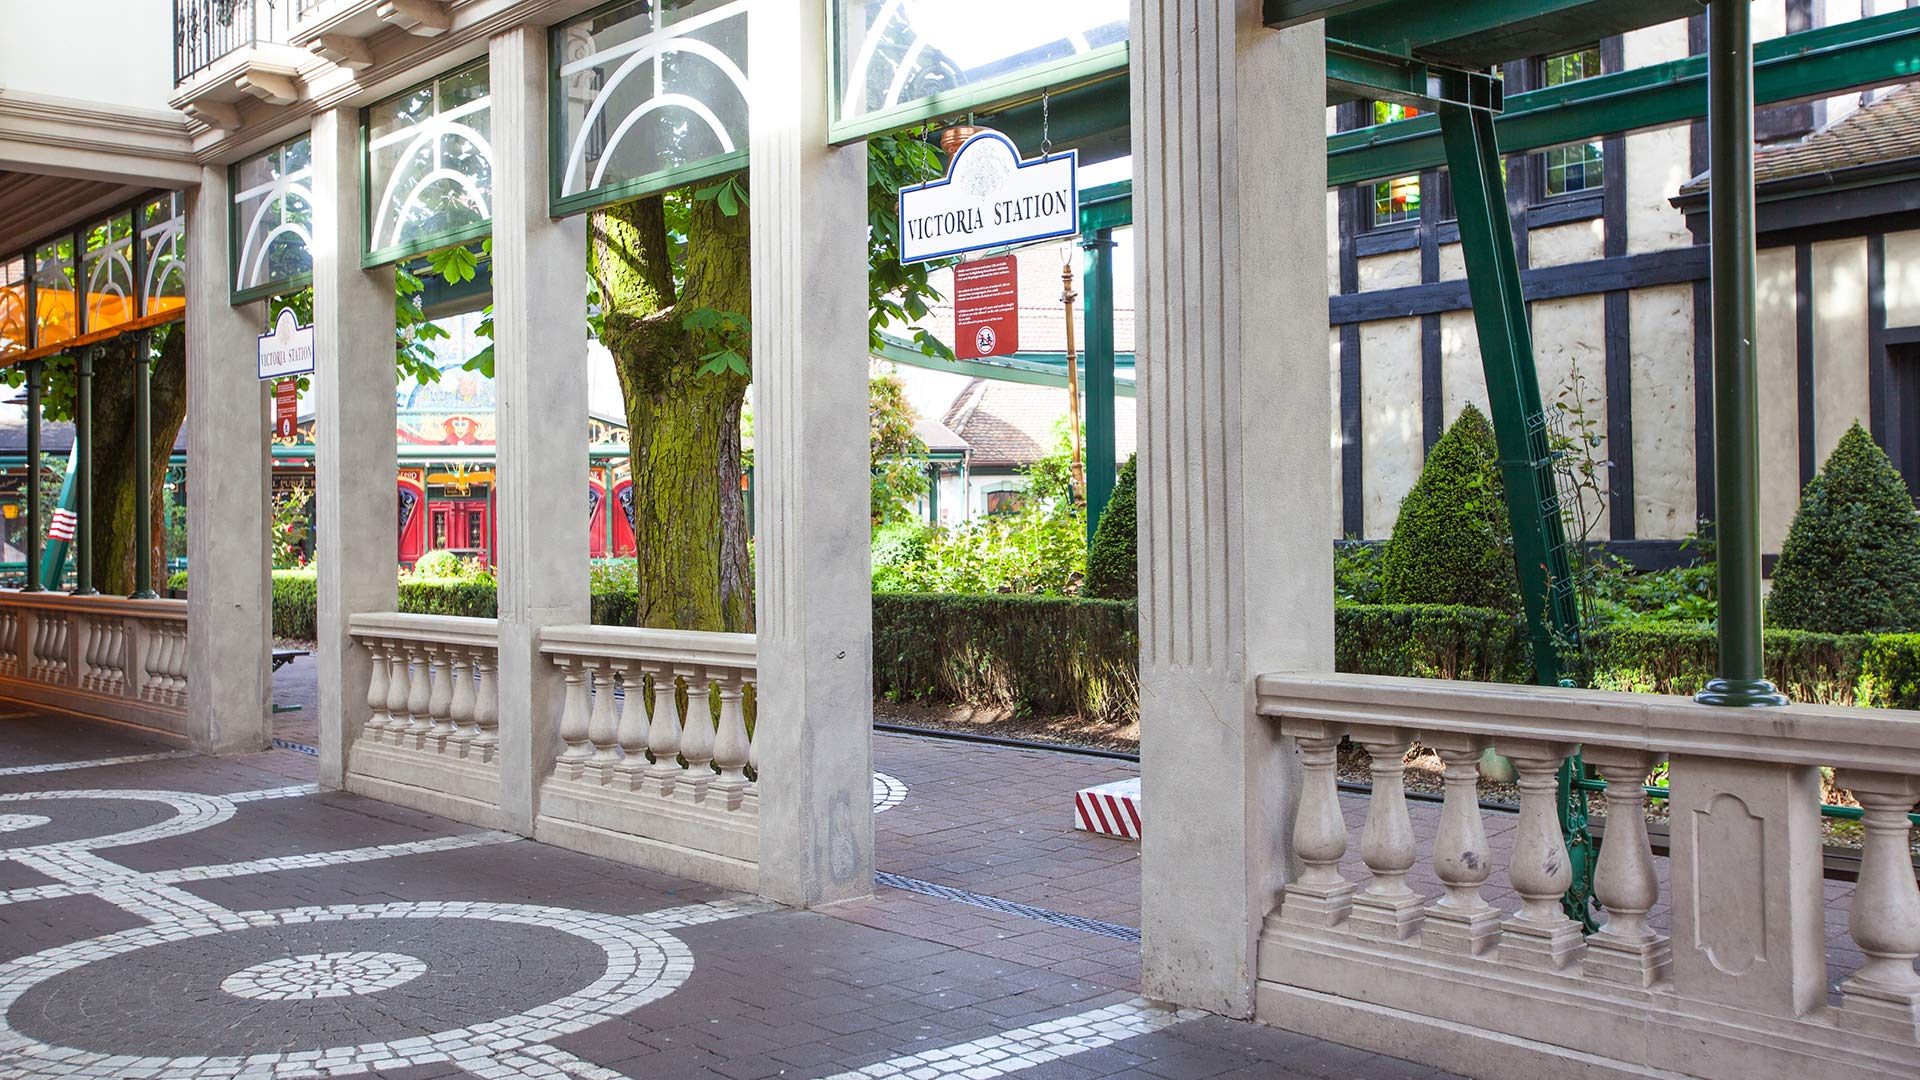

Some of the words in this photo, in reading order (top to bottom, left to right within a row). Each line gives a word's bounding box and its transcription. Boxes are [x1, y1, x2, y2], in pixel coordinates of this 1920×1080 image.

[908, 207, 983, 240] VICTORIA
[994, 190, 1068, 226] STATION
[261, 350, 286, 368] VICTORIA
[288, 345, 312, 363] STATION
